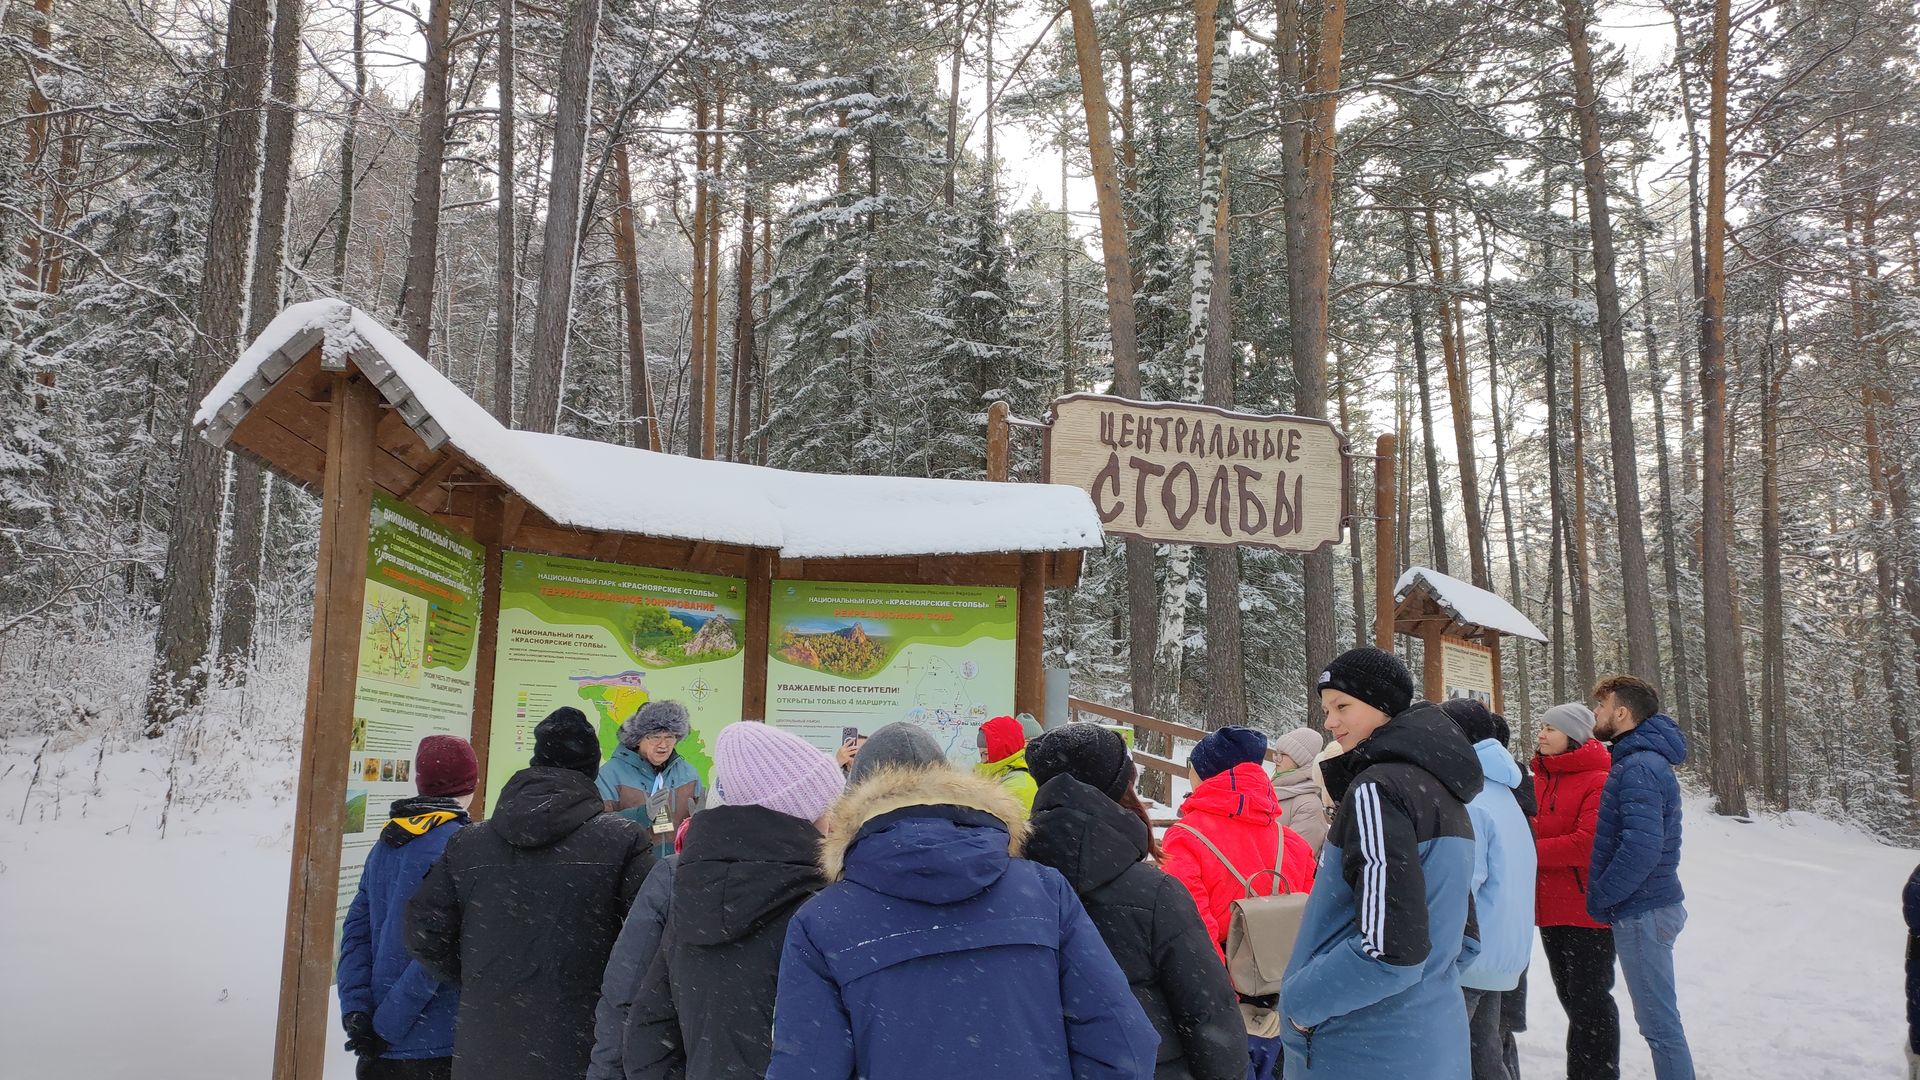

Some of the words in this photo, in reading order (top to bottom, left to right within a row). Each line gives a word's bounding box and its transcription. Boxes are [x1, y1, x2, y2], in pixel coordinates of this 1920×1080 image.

[1101, 411, 1302, 463] ЦЕНТРАЛЬНЫЕ
[1091, 452, 1303, 537] СТОЛБЫ
[383, 508, 420, 537] ВНИМАНИЕ,
[420, 526, 449, 549] ОПАСНЫЙ
[538, 573, 598, 585] НАЦИОНАЛЬНЫЙ
[598, 579, 617, 587] ПАРК
[618, 581, 682, 595] «КРАСНОЯРСКИЕ
[683, 587, 718, 598] СТОЛБЫ»
[808, 596, 865, 605] НАЦИОНАЛЬНЫЙ
[885, 598, 950, 607] «КРАСНОЯРСКИЕ
[952, 600, 990, 608] СТОЛБЫ»
[511, 628, 574, 638] НАЦИОНАЛЬНЫЙ
[511, 637, 572, 647] «КРАСНОЯРСКИЕ
[574, 641, 607, 649] СТОЛБЫ»
[777, 684, 836, 692] УВАЖАЕМЫЕ
[838, 685, 900, 694] ПОСЕТИТЕЛИ!
